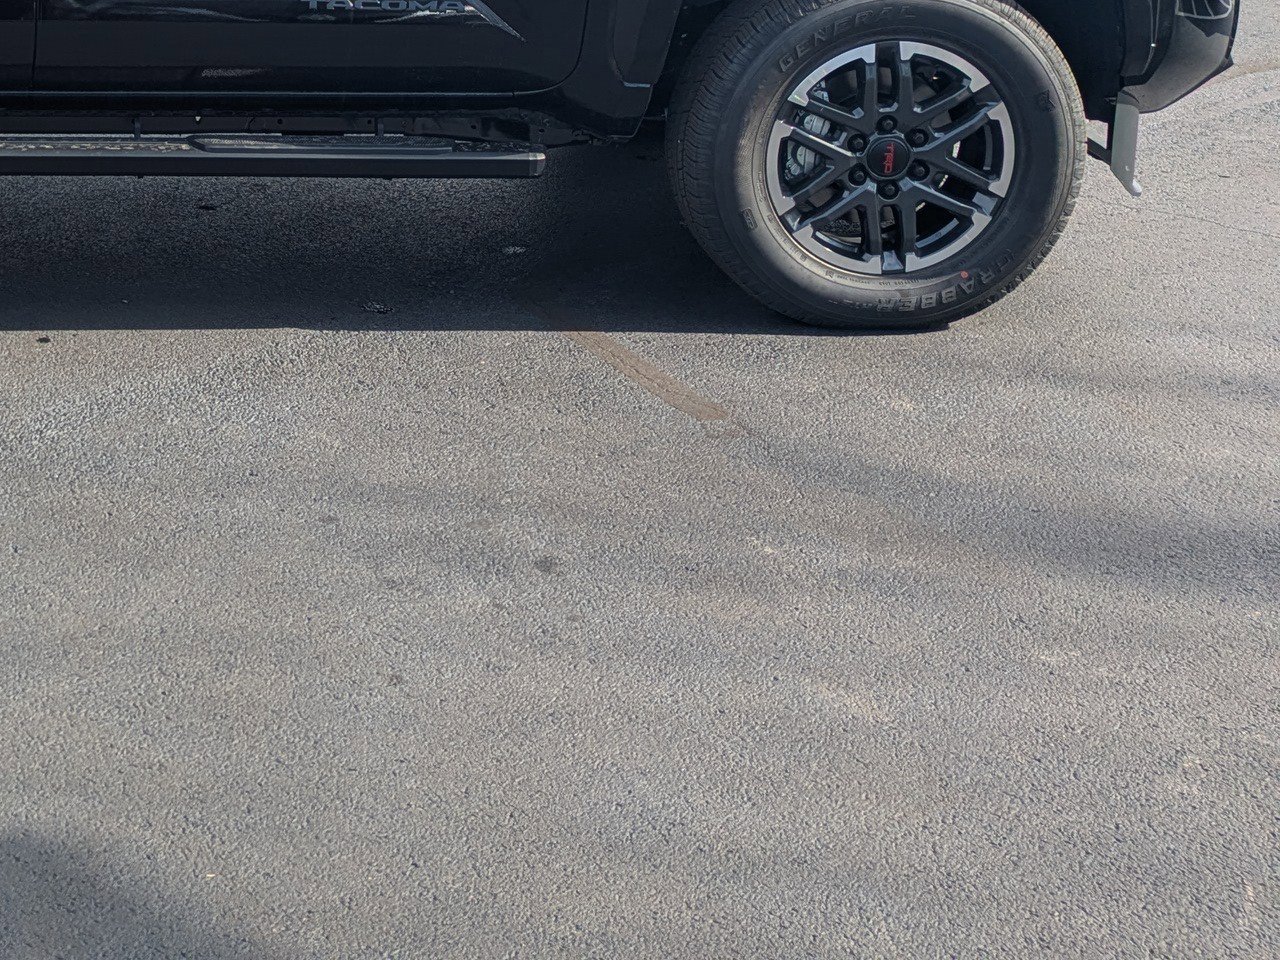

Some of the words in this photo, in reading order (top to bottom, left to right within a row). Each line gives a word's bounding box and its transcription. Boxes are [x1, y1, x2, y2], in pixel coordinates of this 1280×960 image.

[778, 6, 916, 73] GENERAL
[883, 142, 895, 174] TRD
[876, 251, 1017, 312] GRABBER
